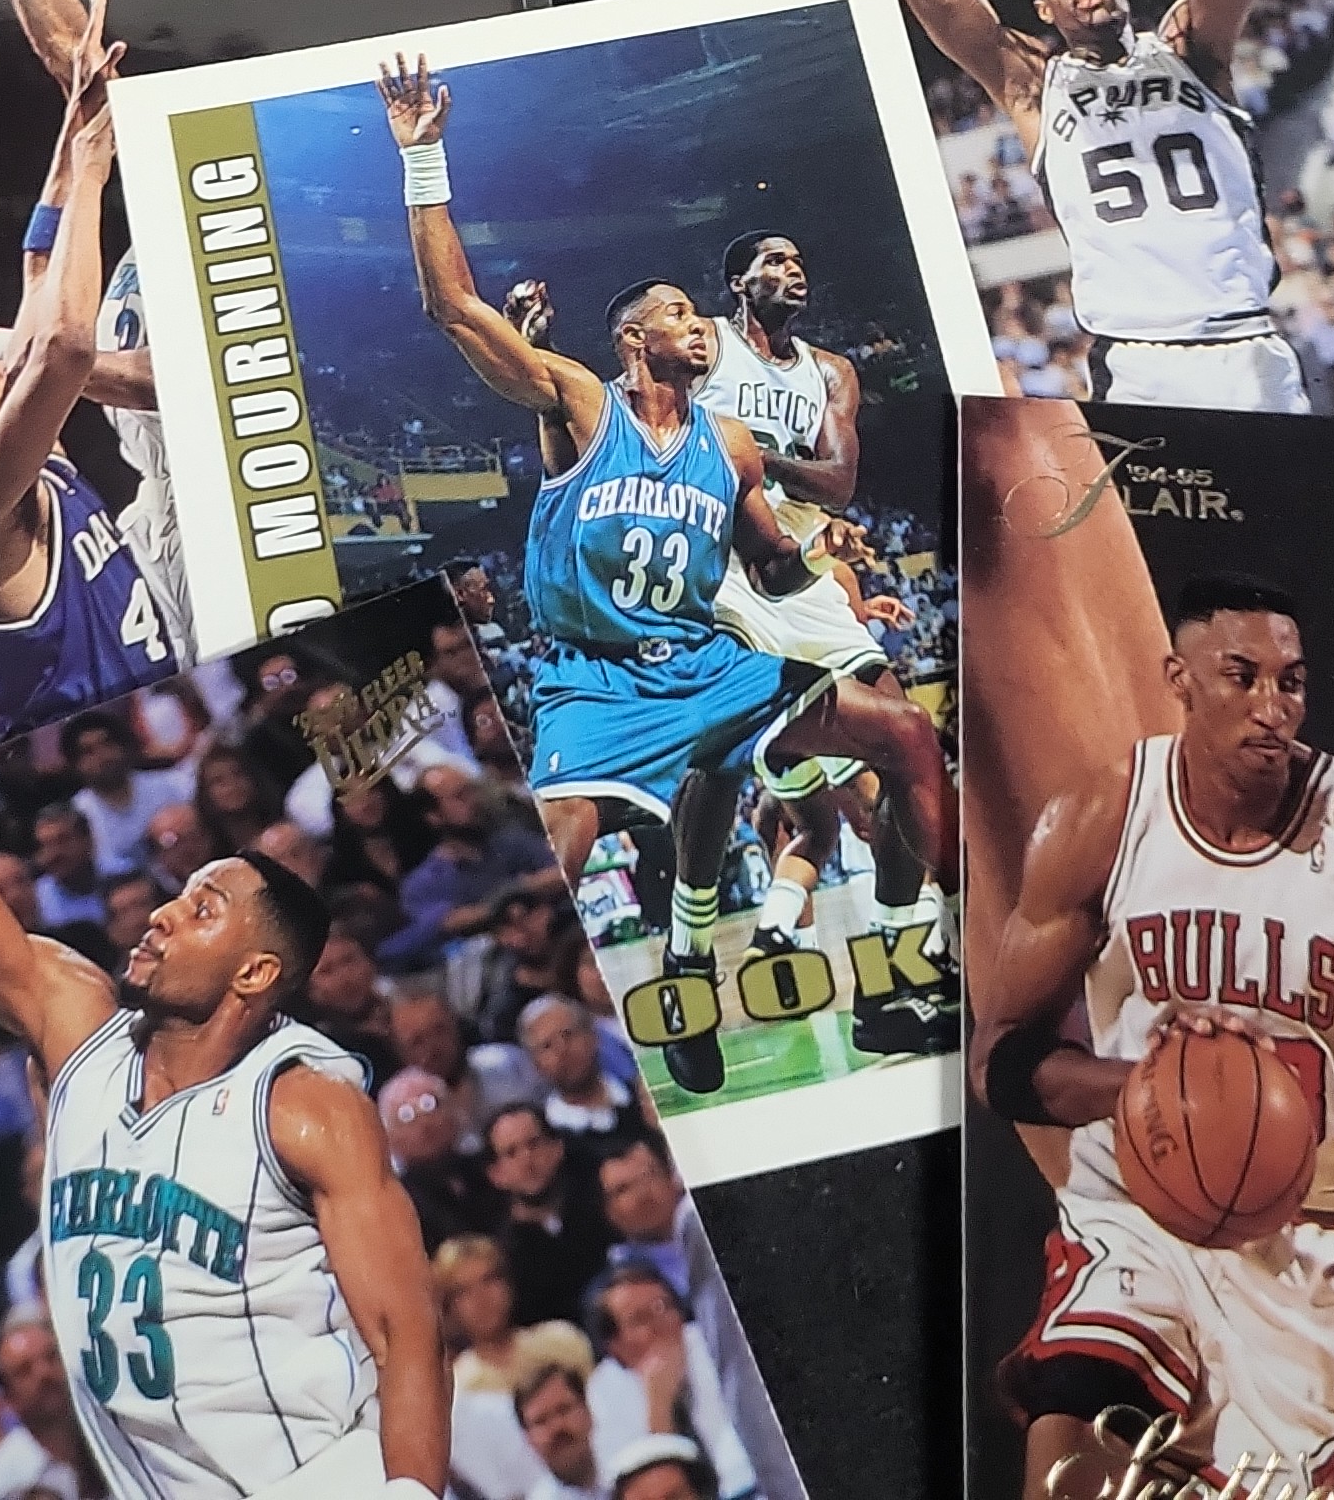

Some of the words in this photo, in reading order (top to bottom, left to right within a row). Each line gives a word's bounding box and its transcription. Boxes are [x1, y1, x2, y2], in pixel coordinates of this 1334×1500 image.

[1053, 77, 1207, 142] SPURS
[1082, 132, 1219, 224] 50
[190, 153, 324, 561] MOURNING
[737, 382, 818, 436] CELTICS
[576, 477, 729, 542] CHARLOTTE
[612, 526, 691, 613] 33
[77, 1249, 175, 1404] 33
